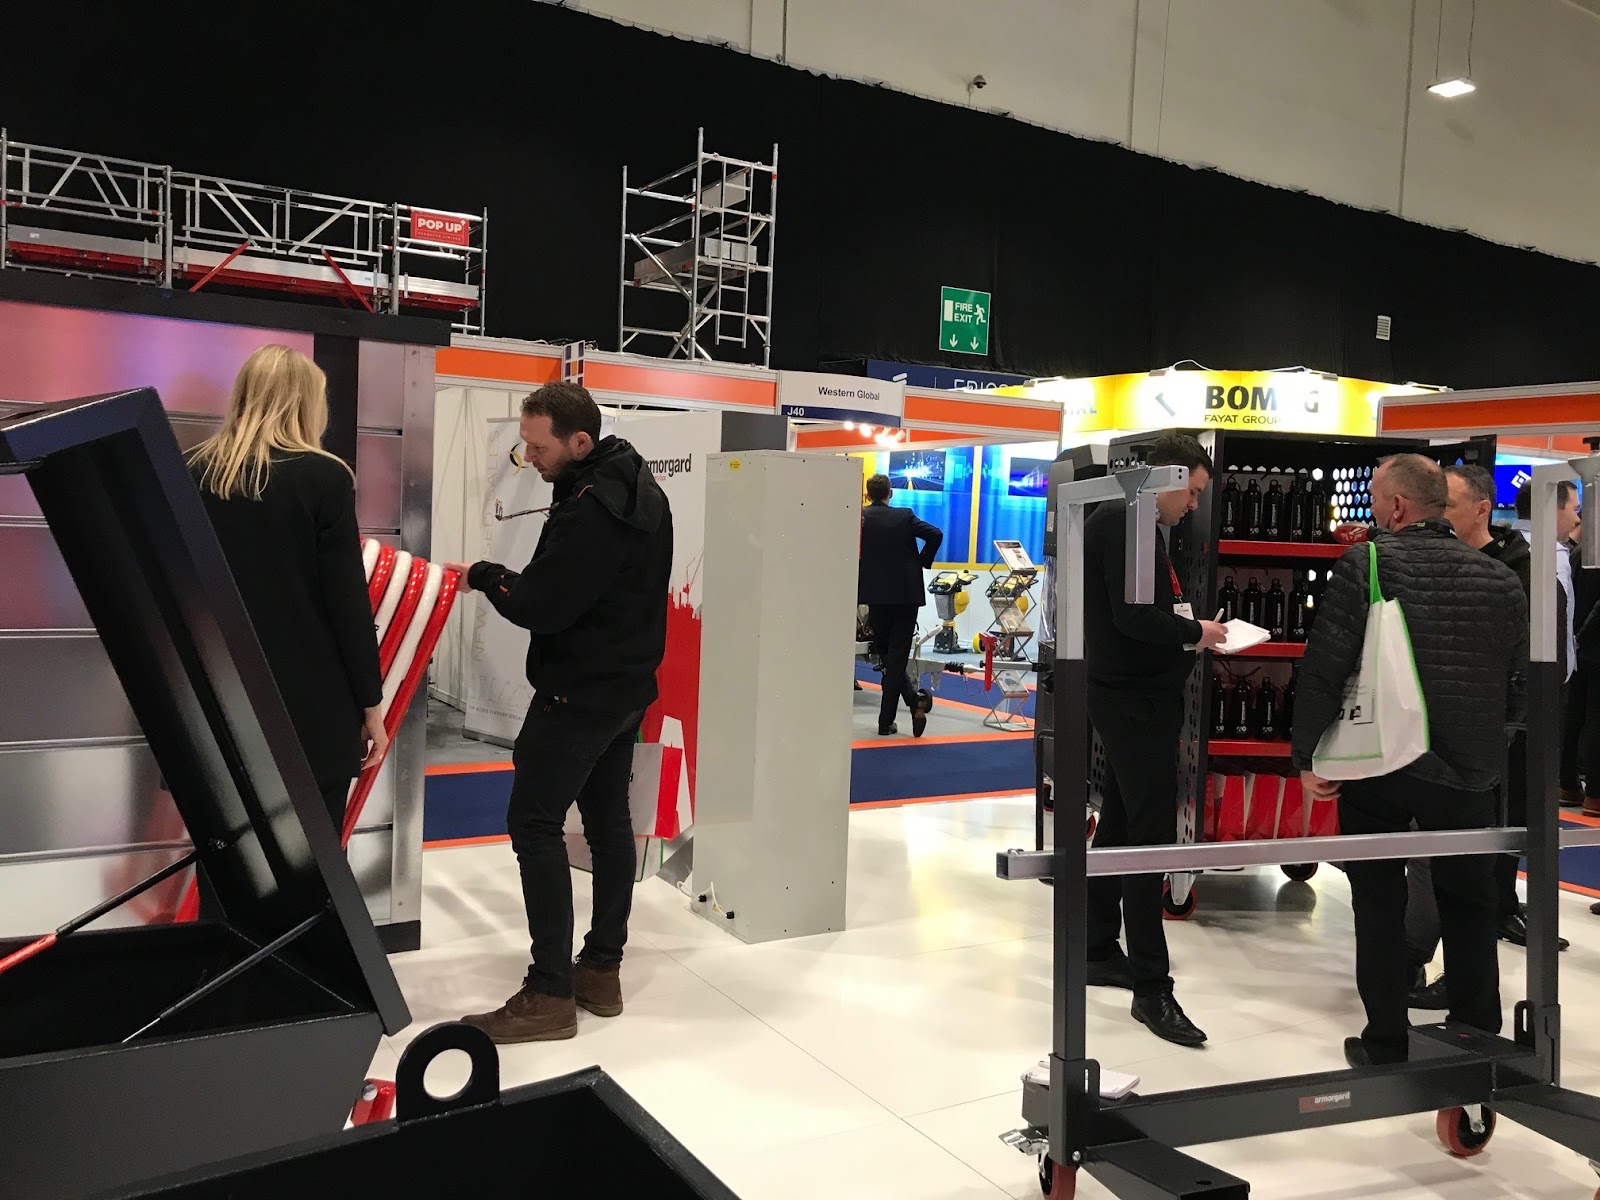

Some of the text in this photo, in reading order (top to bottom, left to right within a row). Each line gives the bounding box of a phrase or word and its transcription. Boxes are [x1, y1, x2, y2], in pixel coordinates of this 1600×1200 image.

[418, 218, 462, 233] POP UP
[955, 302, 973, 313] FIRE
[954, 312, 973, 323] EXIT
[818, 387, 880, 401] Western Global
[1205, 385, 1319, 413] BOMG
[787, 407, 804, 417] J40
[1204, 414, 1281, 425] FAYAT GROUP
[473, 606, 487, 662] NEW
[481, 512, 494, 560] SED
